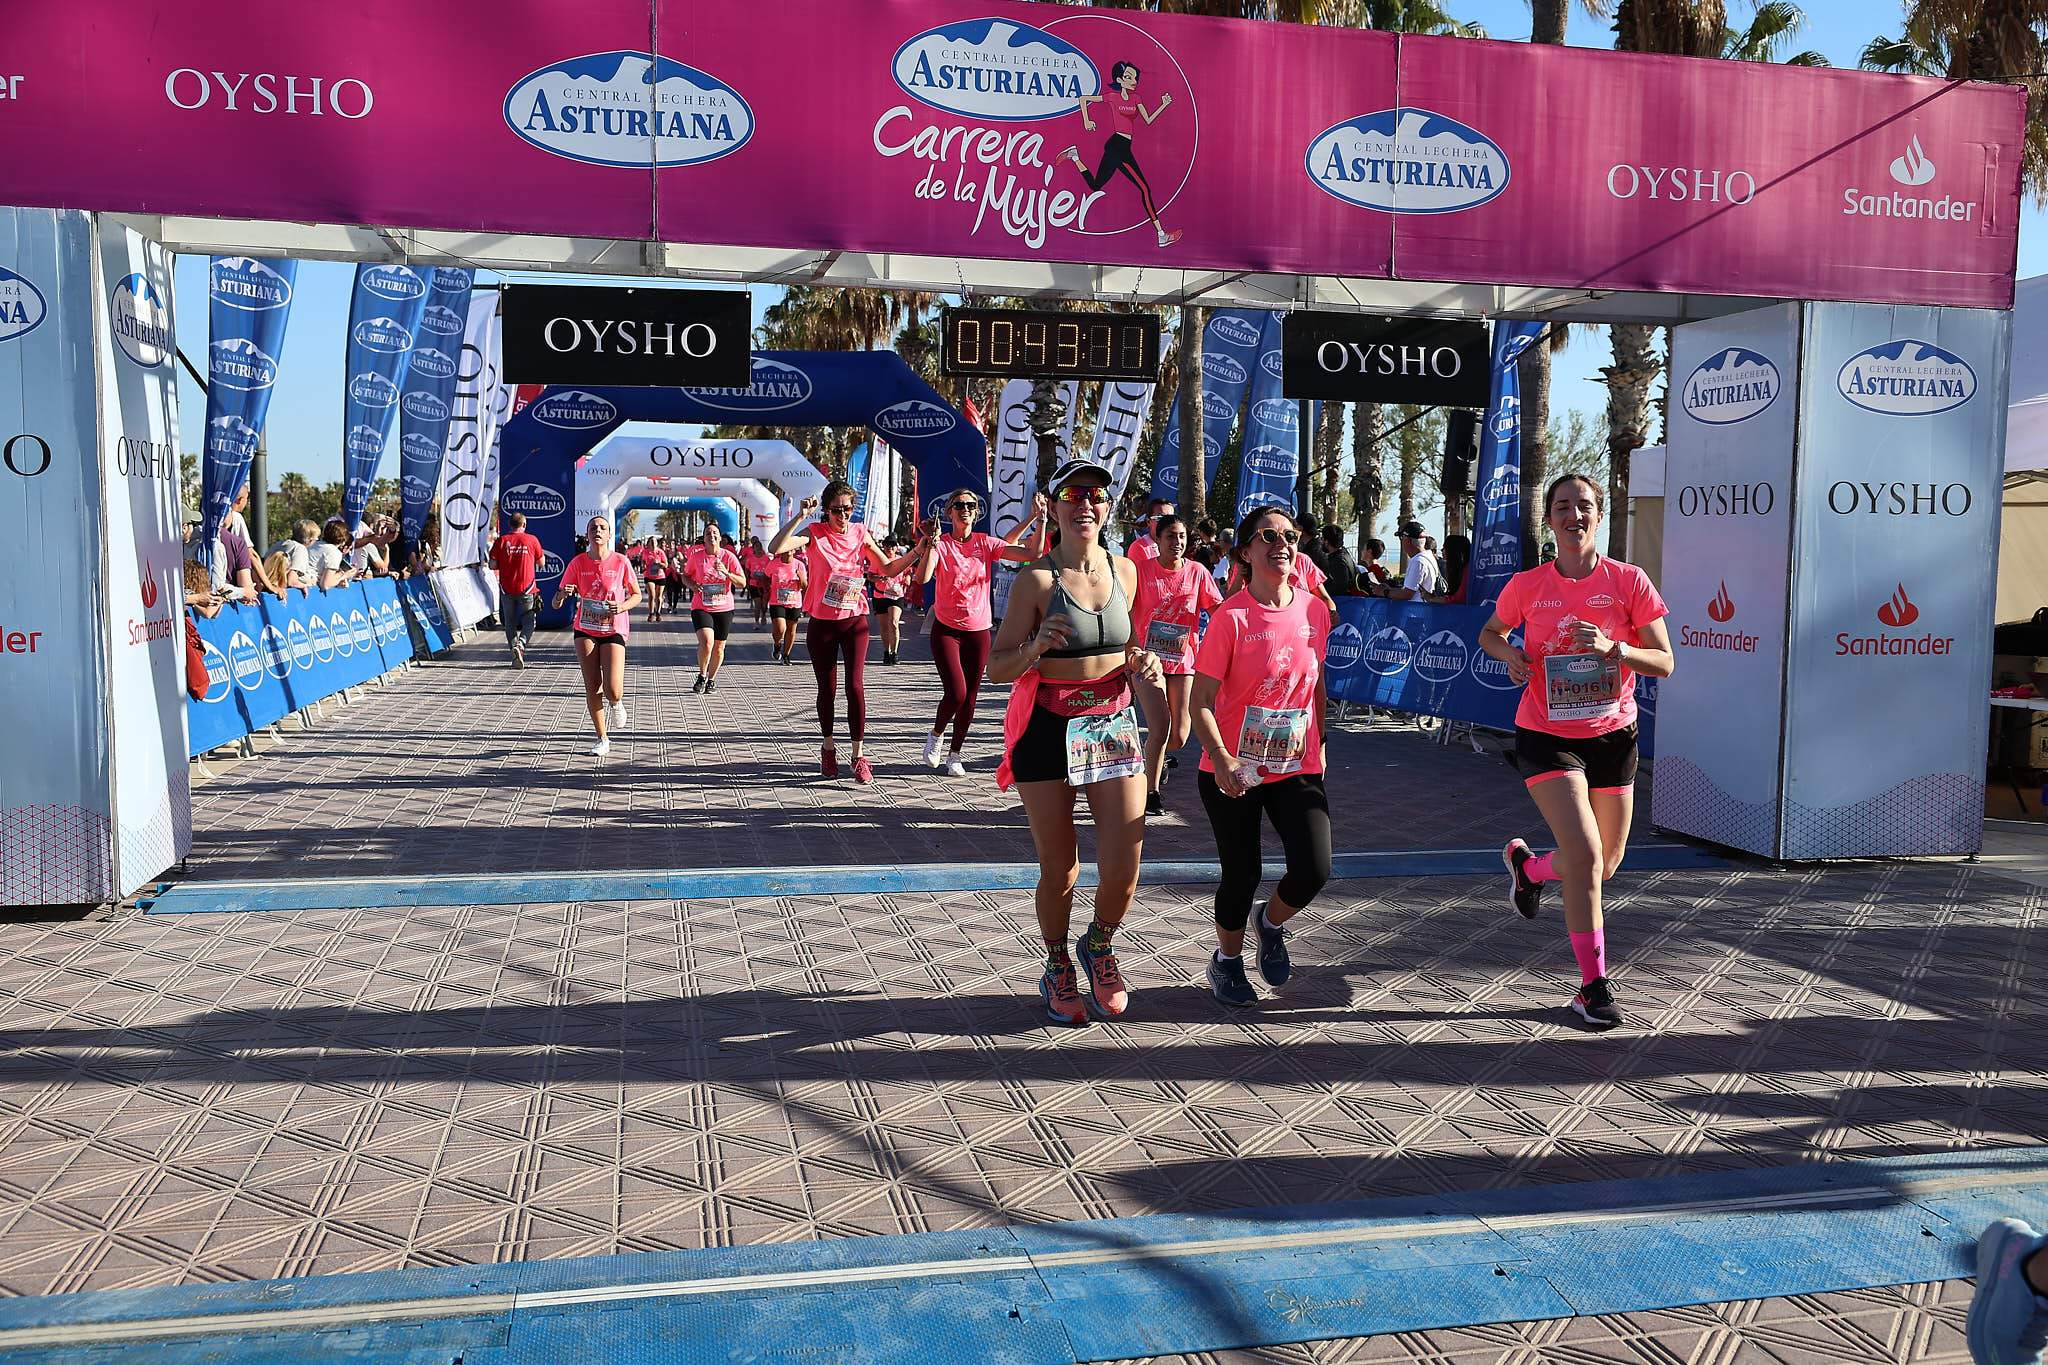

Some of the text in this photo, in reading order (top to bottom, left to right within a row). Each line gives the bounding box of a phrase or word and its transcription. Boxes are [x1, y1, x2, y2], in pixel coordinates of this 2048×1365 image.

[941, 49, 1078, 69] CENTRAL LECHERA
[908, 49, 1083, 99] ASTURIANA
[165, 68, 374, 119] OYSHO
[563, 88, 641, 102] CENTRAL
[524, 89, 735, 141] ASTURIANA
[873, 105, 1043, 168] Carrera
[1321, 142, 1494, 189] ASTURIANA
[1424, 146, 1489, 159] LECHERA
[1607, 163, 1756, 205] OYSHO
[914, 164, 1106, 249] de la Mujer
[1844, 188, 1976, 222] Santander
[544, 317, 717, 357] OYSHO
[1317, 340, 1462, 378] OYSHO
[1869, 365, 1962, 376] CENTRAL LECHERA
[1687, 380, 1772, 409] ASTURIANA
[1847, 366, 1965, 397] ASTURIANA
[537, 404, 610, 420] ASTURIANA
[882, 414, 951, 429] ASTURIANA
[117, 436, 173, 481] OYSHO
[650, 445, 754, 468] OYSHO
[587, 468, 620, 476] OYSHO
[782, 470, 813, 478] OYSHO
[504, 496, 561, 511] ASTURIANA
[1679, 482, 1774, 516] OYSHO
[1828, 481, 1972, 516] OYSHO
[128, 617, 173, 646] Santander
[1681, 625, 1760, 653] Santander
[1835, 633, 1954, 656] Santander
[1417, 646, 1462, 670] ASTURIANA
